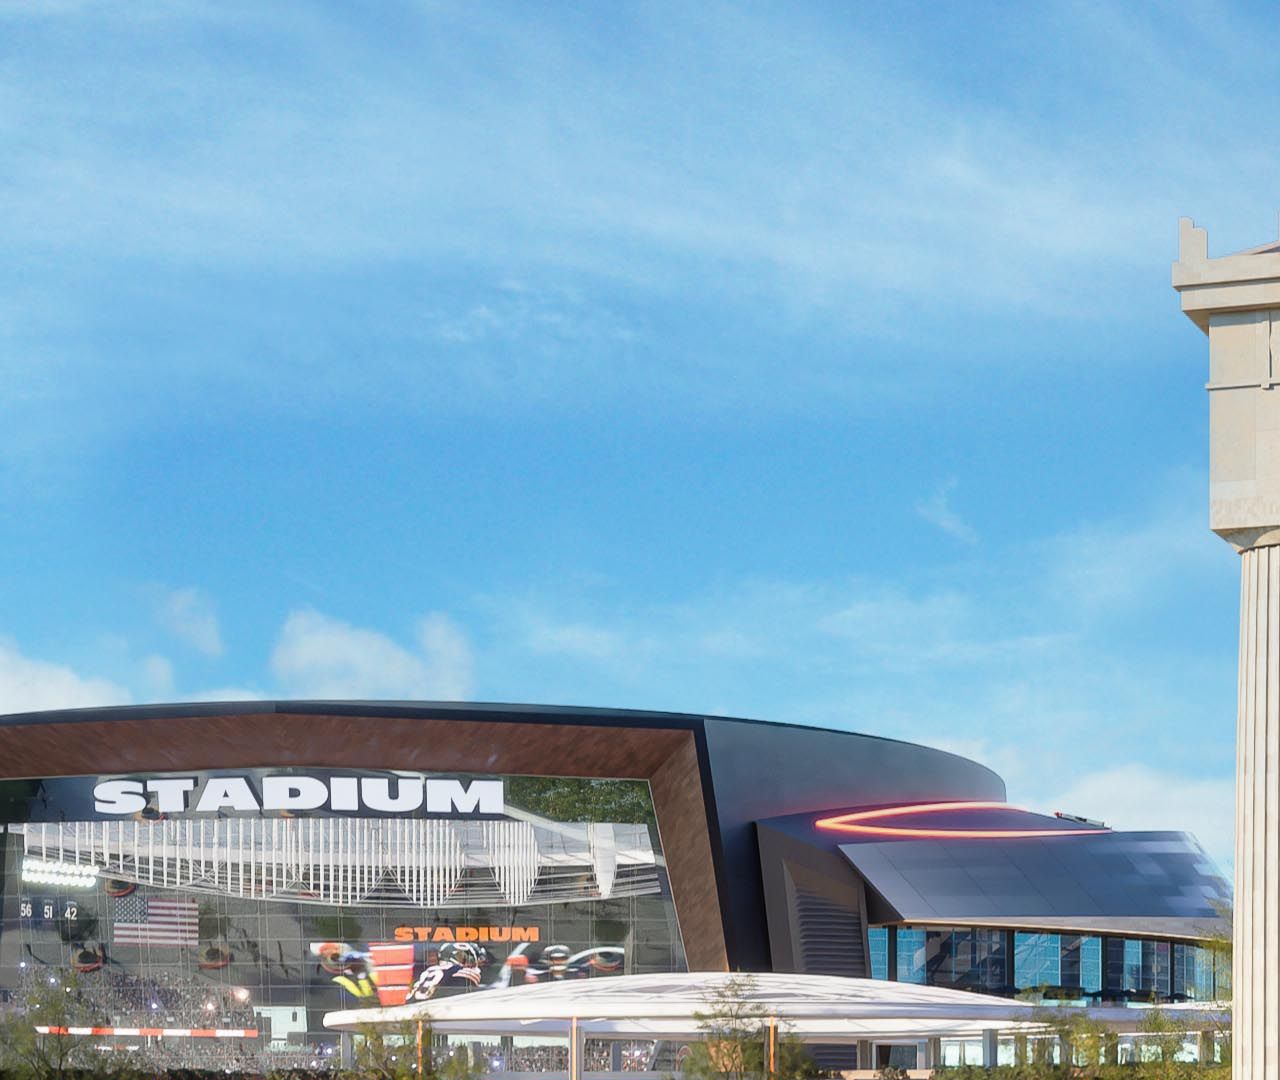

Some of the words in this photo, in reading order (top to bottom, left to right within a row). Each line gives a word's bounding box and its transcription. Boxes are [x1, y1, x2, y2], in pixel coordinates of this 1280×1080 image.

[93, 776, 504, 814] STADIUM
[20, 903, 32, 917] 56
[64, 907, 78, 920] 42
[393, 926, 539, 942] STADIUM
